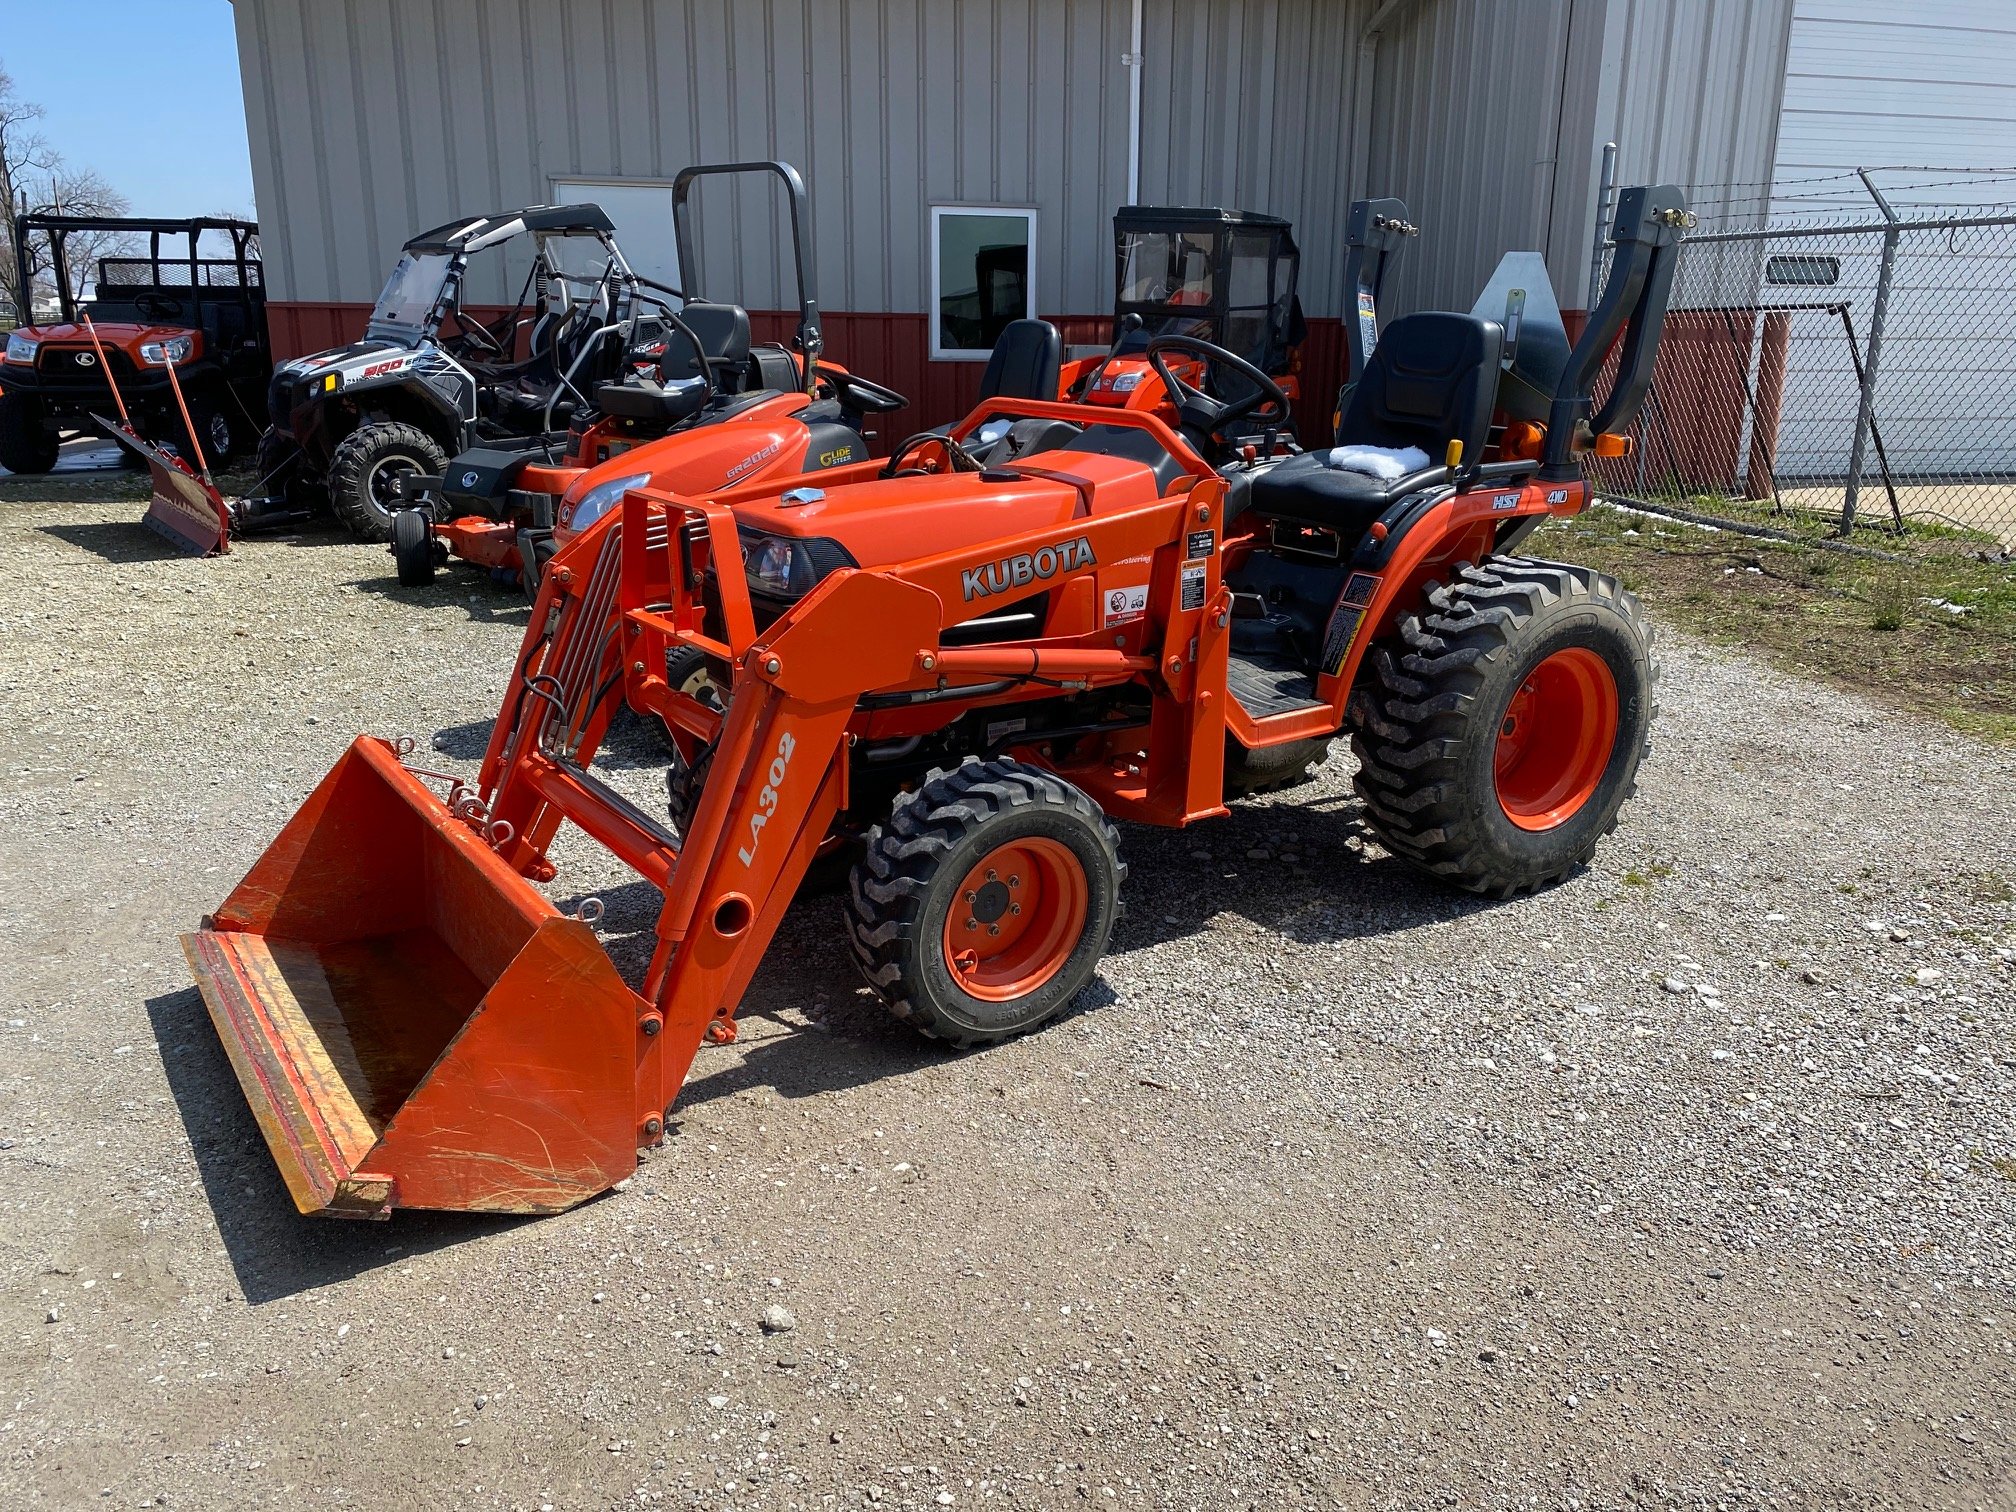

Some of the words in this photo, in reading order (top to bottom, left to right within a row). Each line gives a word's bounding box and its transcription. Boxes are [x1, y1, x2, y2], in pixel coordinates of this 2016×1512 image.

[364, 358, 404, 377] 900
[726, 441, 780, 479] GR2020
[820, 445, 852, 467] GLIDE
[832, 455, 852, 466] STEER
[1491, 493, 1521, 510] HST
[1547, 488, 1569, 505] 4WD
[961, 536, 1097, 602] KUBOTA
[738, 731, 797, 869] LA302
